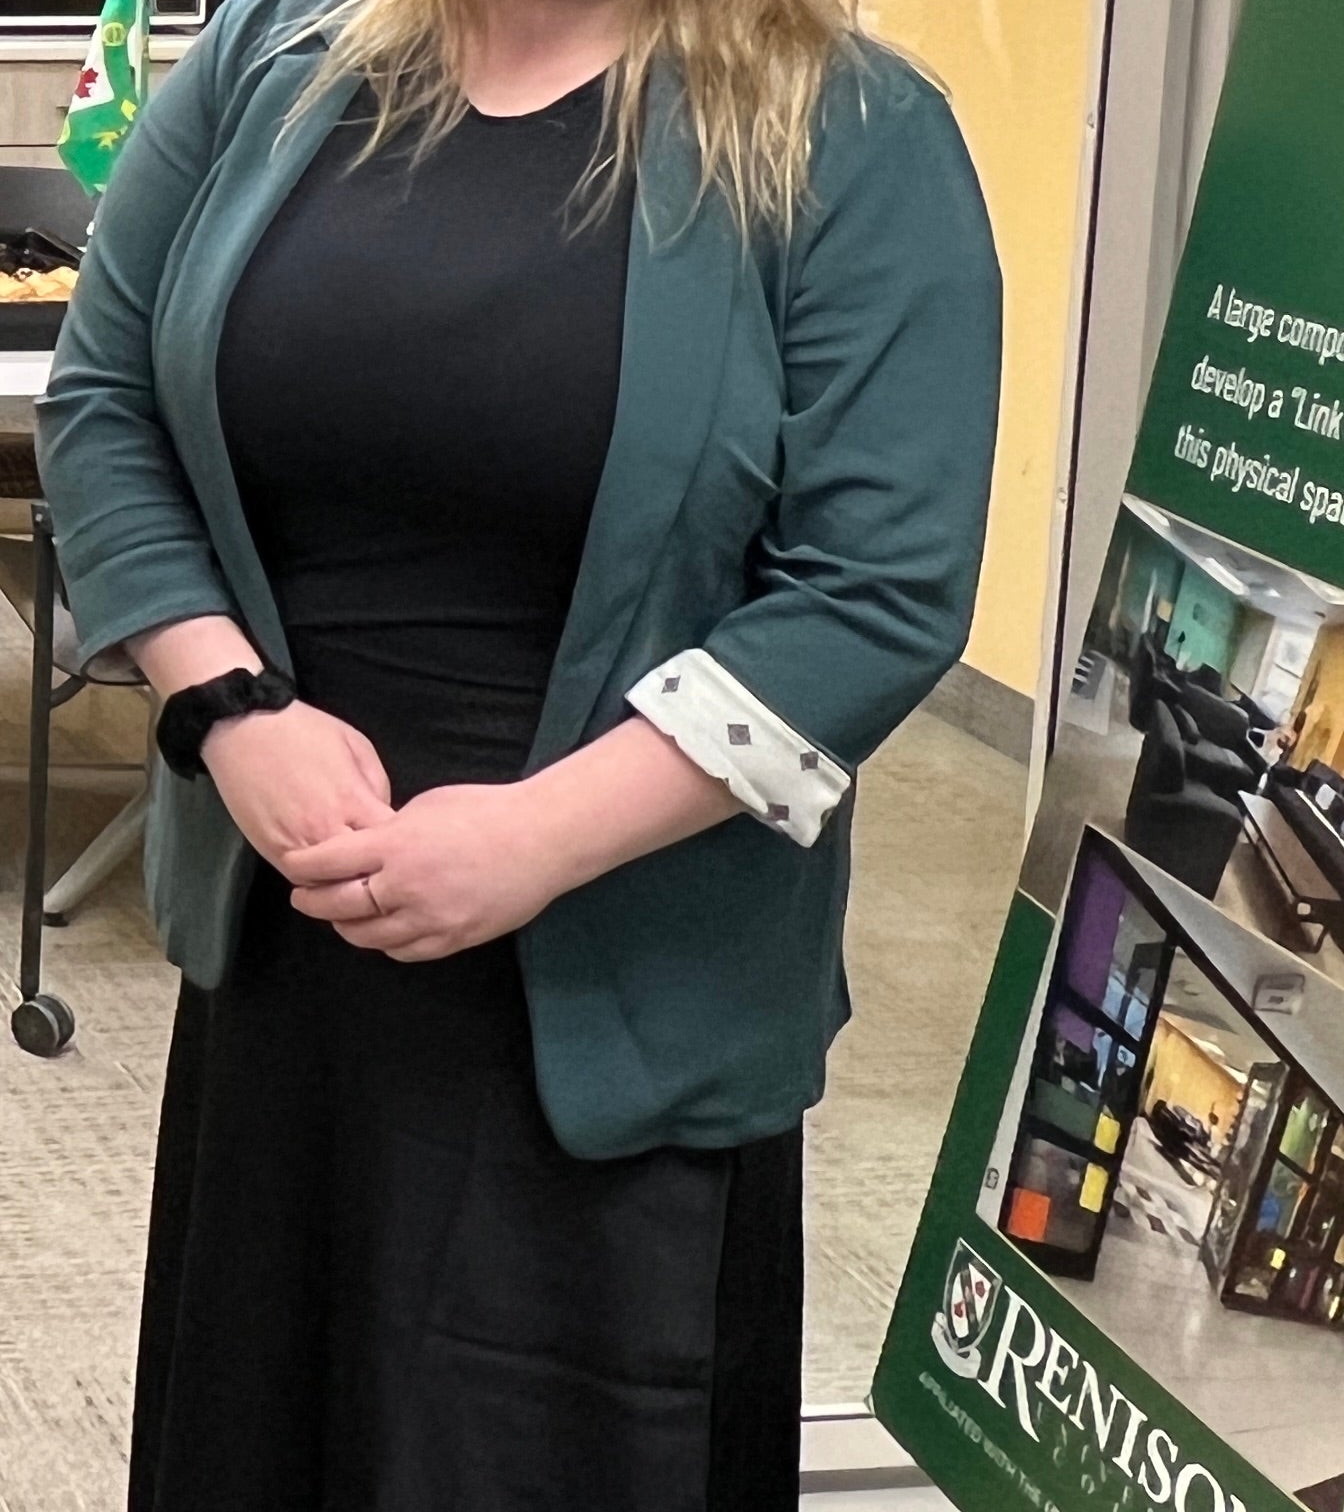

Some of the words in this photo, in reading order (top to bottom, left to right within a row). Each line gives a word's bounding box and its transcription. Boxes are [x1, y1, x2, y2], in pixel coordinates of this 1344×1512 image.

[1206, 283, 1225, 321] A
[1223, 287, 1276, 344] large
[1190, 354, 1266, 420] develop
[1267, 388, 1284, 419] a
[1173, 423, 1212, 470] this
[1210, 441, 1300, 505] physical
[976, 1284, 1248, 1512] RENISO
